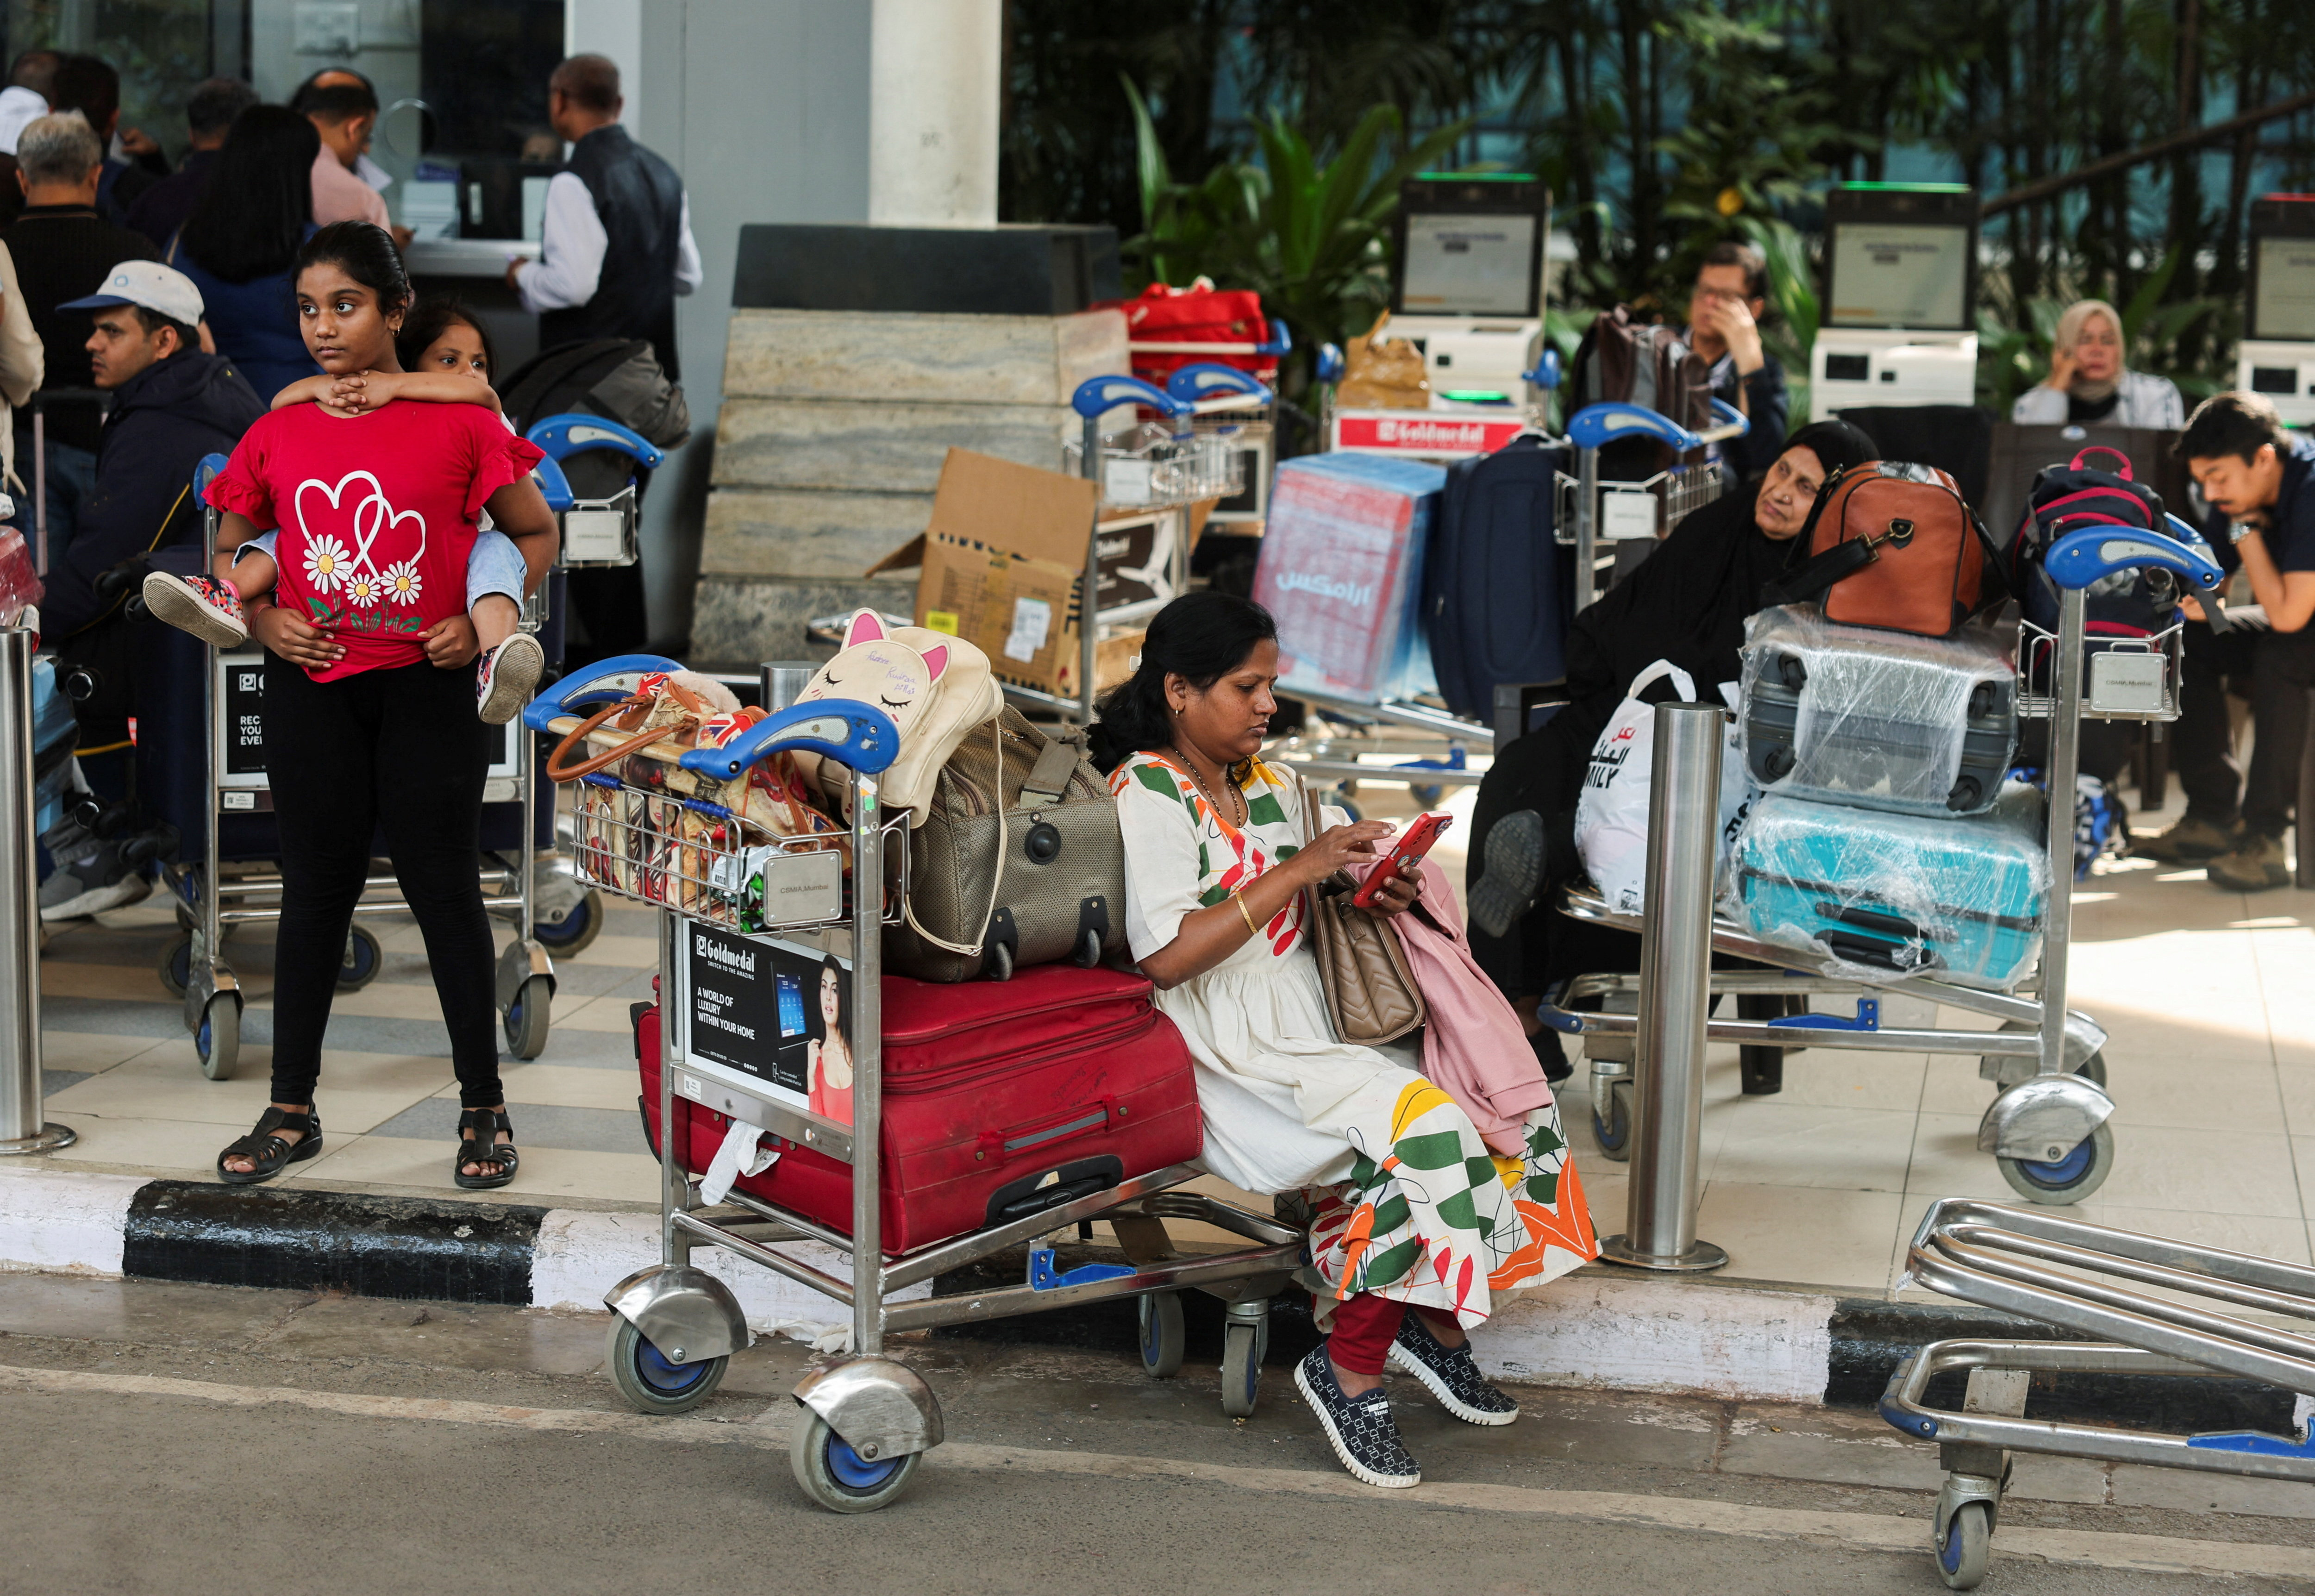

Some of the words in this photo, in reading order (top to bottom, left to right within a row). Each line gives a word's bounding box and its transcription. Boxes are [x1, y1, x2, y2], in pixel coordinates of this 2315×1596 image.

[240, 736, 262, 745] EVE
[1585, 765, 1620, 789] MILY
[707, 939, 755, 973] Goldmedal
[707, 960, 722, 970] SWITCH
[737, 970, 755, 981] AMAZING
[697, 986, 702, 997] A
[702, 988, 725, 1004] WORLD
[725, 995, 734, 1007] OF
[698, 998, 721, 1015] LUXURY
[698, 1011, 719, 1027] WITHIN
[720, 1018, 737, 1034] YOUR
[737, 1024, 755, 1040] HOME
